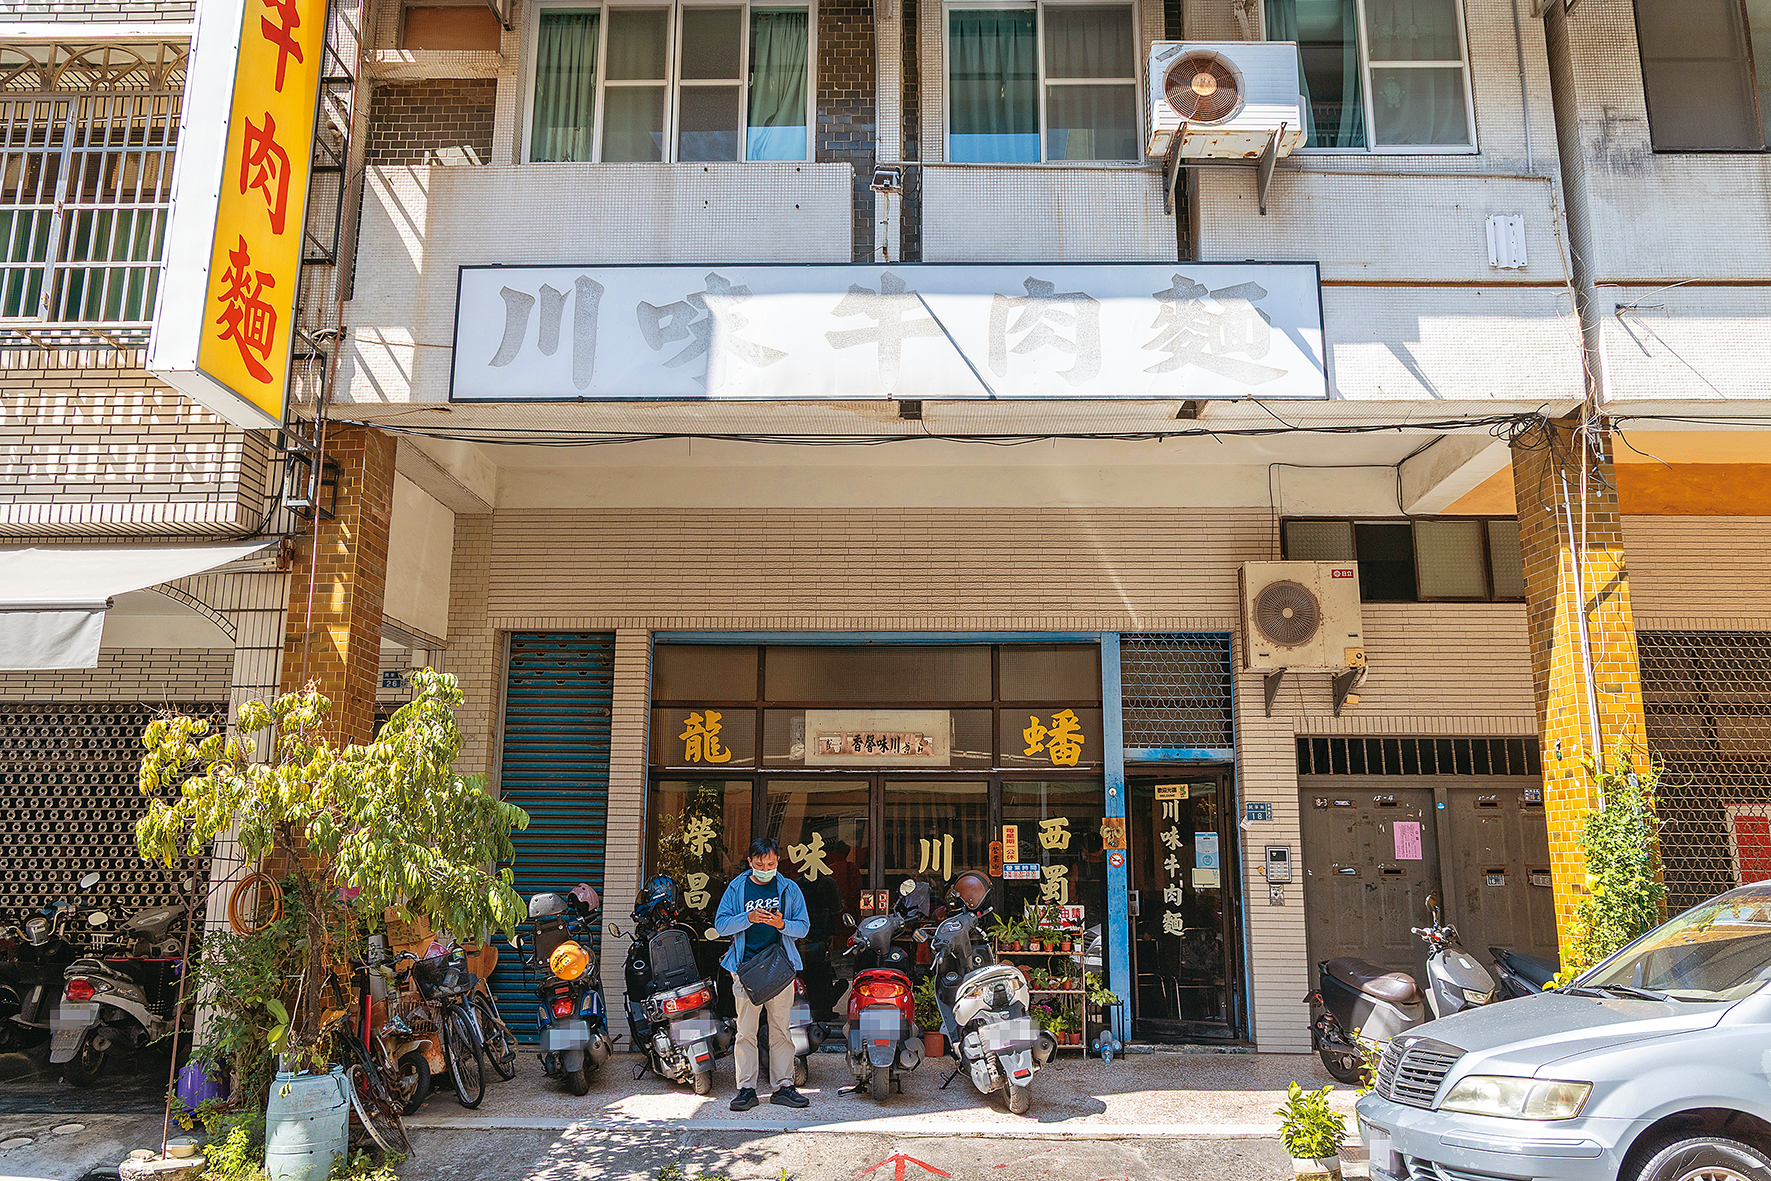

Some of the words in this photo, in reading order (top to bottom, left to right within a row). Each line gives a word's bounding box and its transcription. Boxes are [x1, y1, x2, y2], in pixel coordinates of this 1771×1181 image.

[216, 0, 304, 384] 牛肉麵
[487, 271, 1290, 391] 川味牛肉麵
[678, 709, 732, 764] 龍
[1022, 708, 1086, 767] 蟠
[1252, 812, 1263, 820] 18
[683, 816, 717, 911] 榮昌
[787, 831, 834, 883] 味
[918, 833, 954, 882] 川
[1038, 817, 1072, 906] 西蜀
[1160, 799, 1185, 937] 川味牛肉麵
